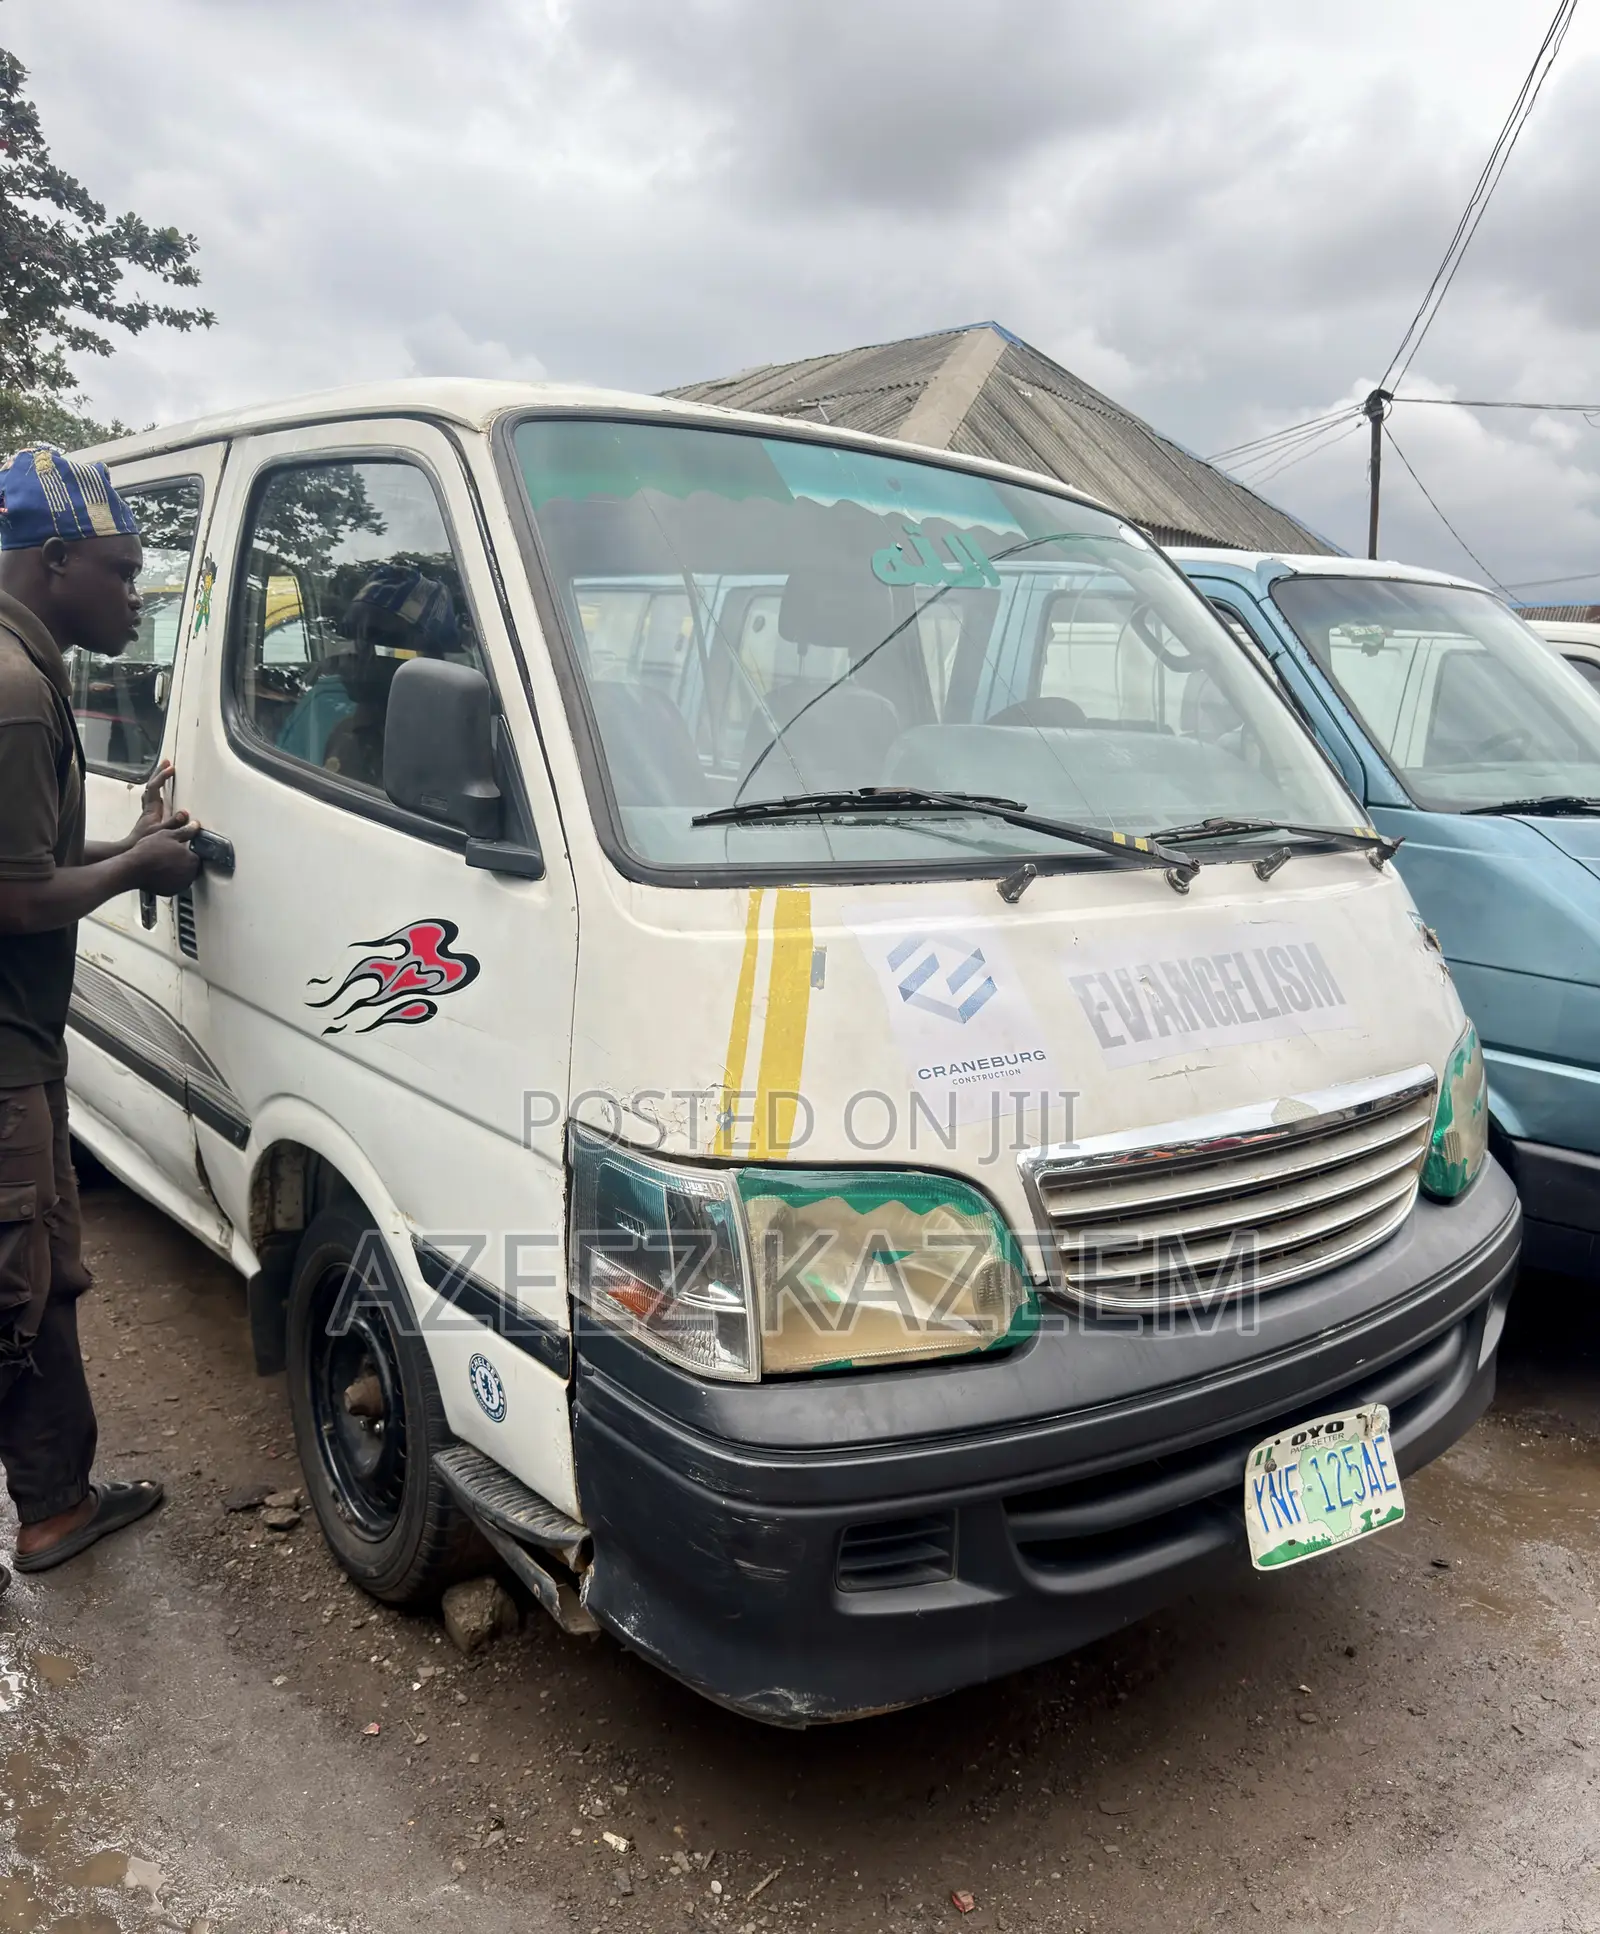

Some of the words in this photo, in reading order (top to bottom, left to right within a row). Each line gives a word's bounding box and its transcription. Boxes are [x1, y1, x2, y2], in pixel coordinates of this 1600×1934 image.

[1069, 942, 1346, 1050] EVANGELISM
[917, 1050, 1047, 1080] CRANEBURG
[952, 1068, 1021, 1085] CONSTRUCTION
[1291, 1420, 1345, 1446] OYO
